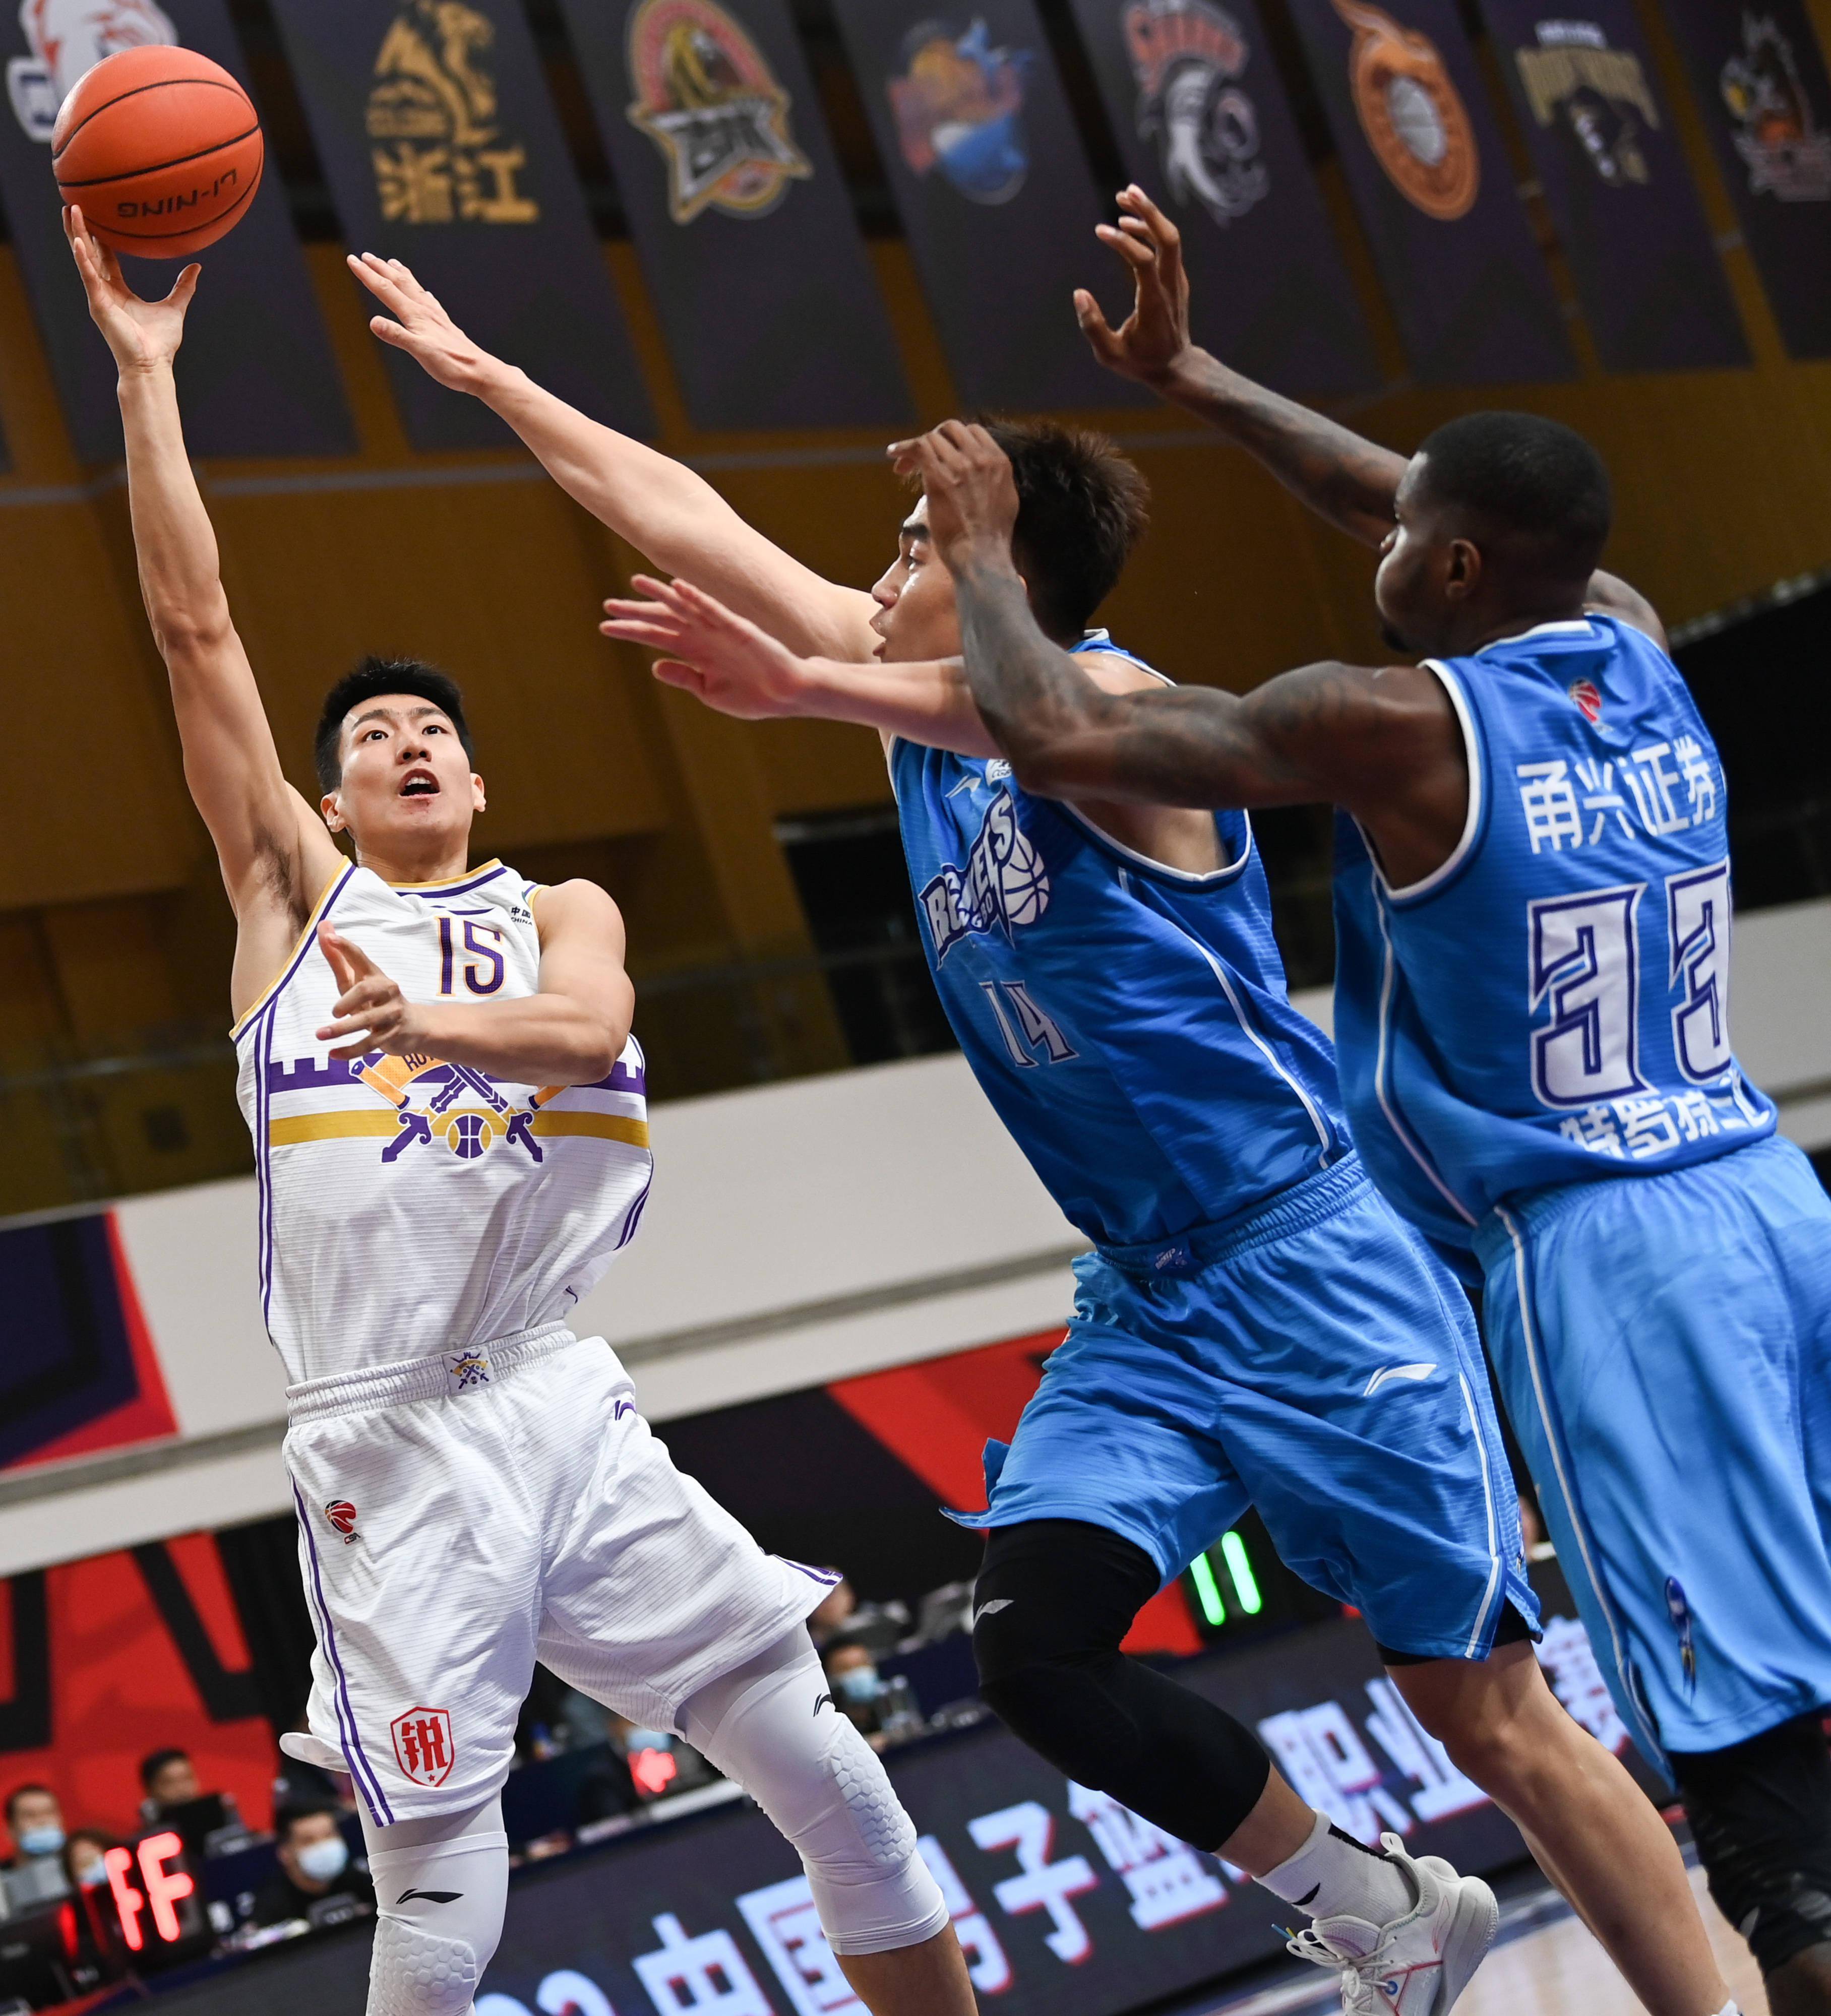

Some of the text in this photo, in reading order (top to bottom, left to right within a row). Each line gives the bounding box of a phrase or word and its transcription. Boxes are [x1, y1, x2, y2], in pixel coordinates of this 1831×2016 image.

[117, 168, 237, 218] LI-NING
[1517, 735, 1716, 854] 甬兴证券
[511, 906, 531, 918] 中国
[511, 917, 533, 926] CHINA
[436, 917, 506, 996] 15
[1528, 856, 1731, 1110] 33
[979, 980, 1079, 1067] 14
[401, 1716, 449, 1774] 锐
